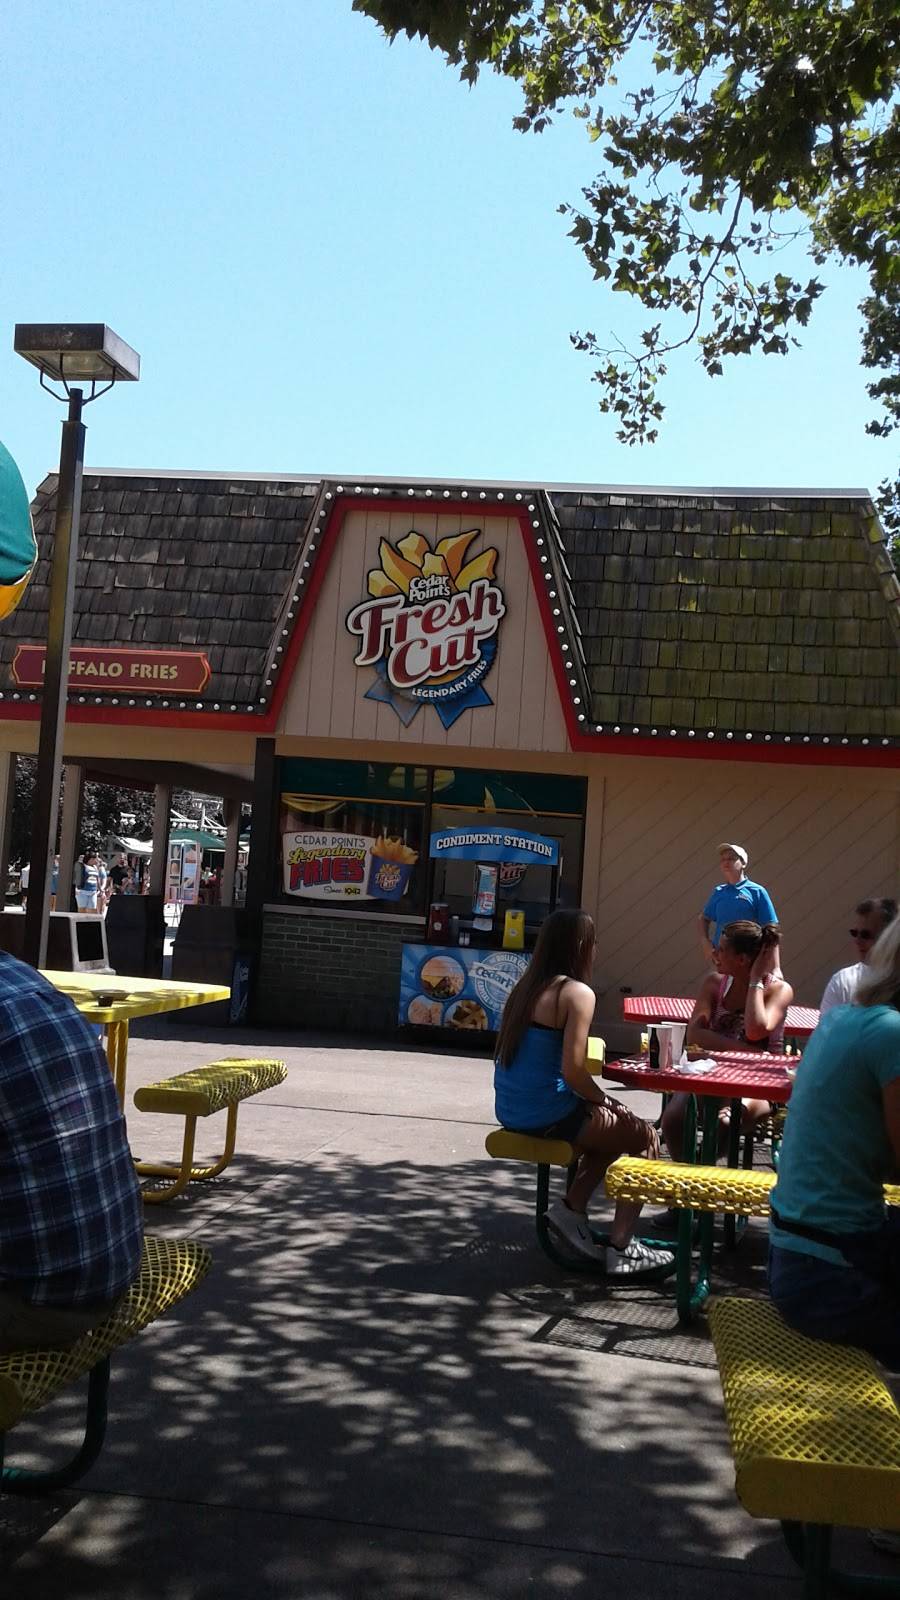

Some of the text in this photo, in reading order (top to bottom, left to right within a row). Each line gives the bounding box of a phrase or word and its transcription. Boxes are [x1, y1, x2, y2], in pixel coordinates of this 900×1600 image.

[410, 575, 449, 589] Cedar
[410, 584, 450, 602] Point's
[349, 582, 503, 663] Fresh
[391, 625, 495, 684] Cut
[41, 659, 178, 680] FFALO FRIES
[412, 660, 487, 698] LEGENDARY FRIES
[294, 835, 366, 848] CEDAR POINT'S
[436, 834, 553, 857] CONDIMENT STATION
[287, 845, 367, 866] Legendary
[289, 857, 365, 891] FRIES
